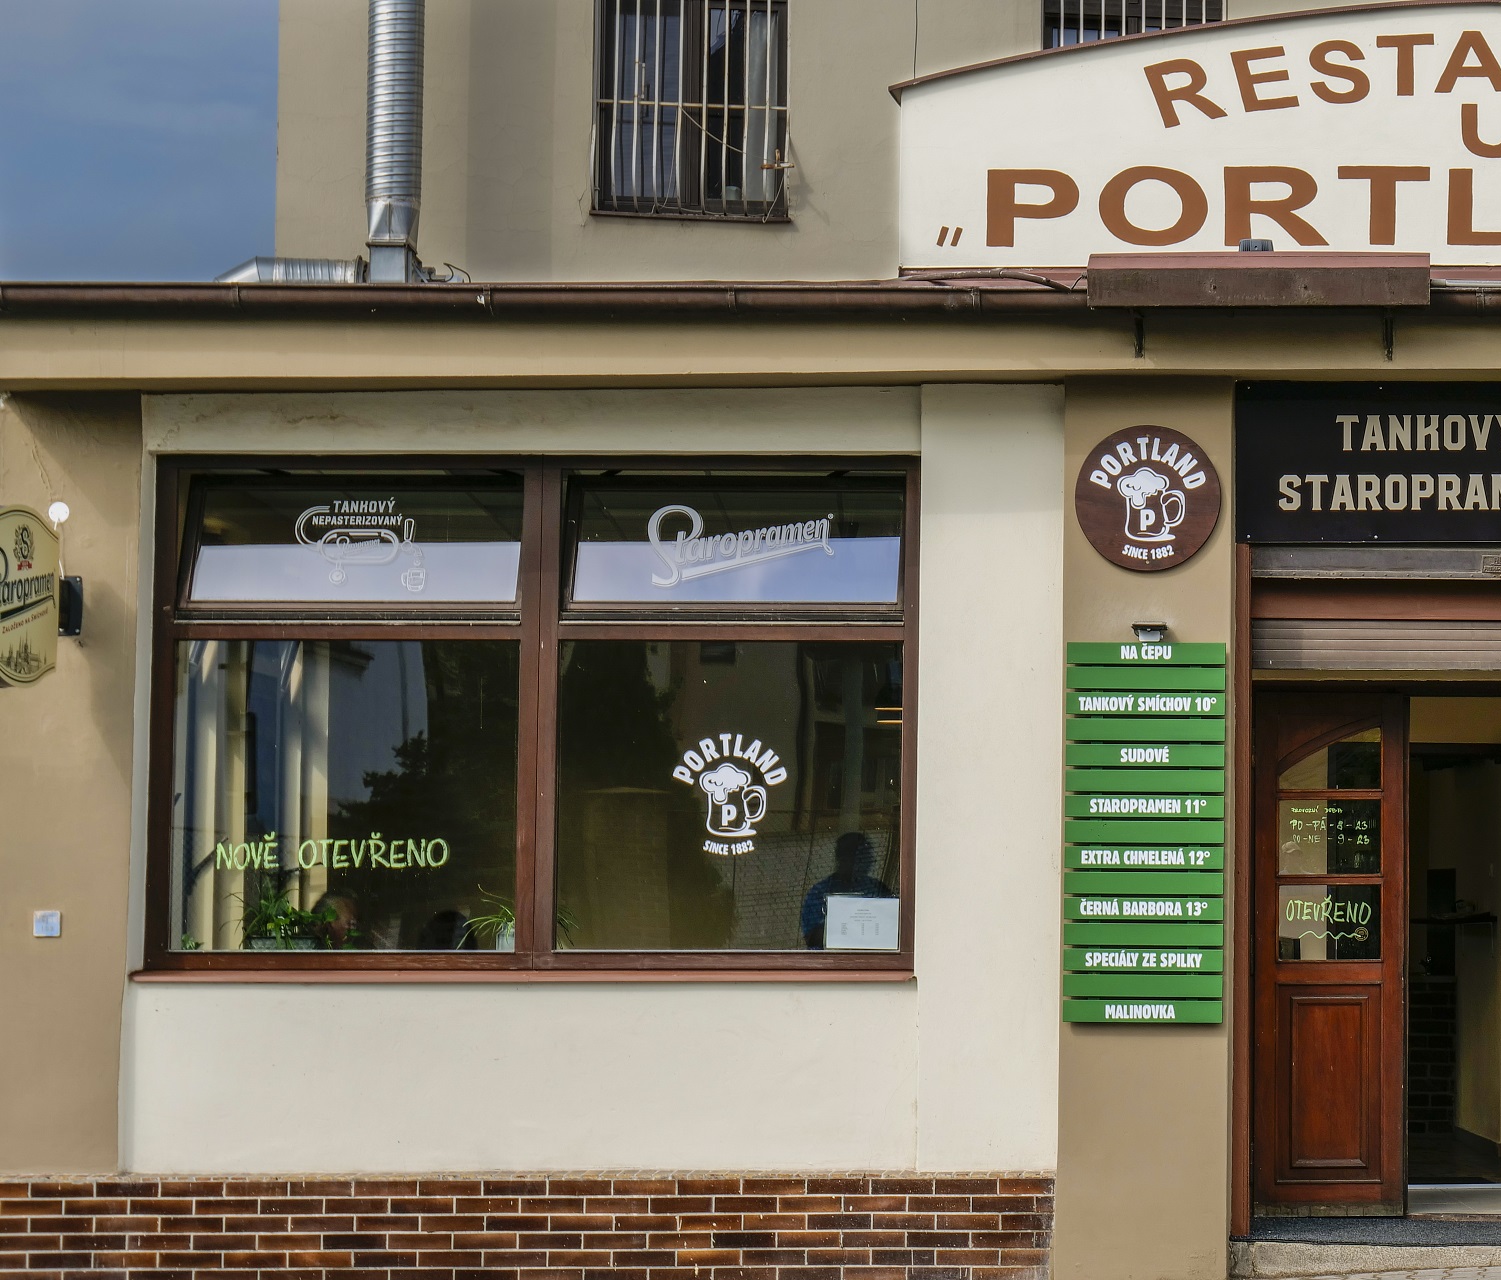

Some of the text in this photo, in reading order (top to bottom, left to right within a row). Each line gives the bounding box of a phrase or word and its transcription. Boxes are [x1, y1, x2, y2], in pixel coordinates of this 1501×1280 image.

[1089, 437, 1207, 490] PORTLAND
[333, 497, 396, 513] TANKOVÝ
[312, 513, 403, 526] NEPASTERIZOVANÝ
[1139, 508, 1156, 531] P
[647, 504, 834, 588] Staropramen
[1121, 544, 1175, 560] SINCE 1882
[1120, 643, 1172, 660] NA ČEPU
[1078, 694, 1217, 712] TANKOVÝ SMÍCHOV 10°
[672, 733, 788, 786] PORTLAND
[1120, 745, 1170, 763] SUDOVÉ
[721, 804, 737, 826] P
[1089, 798, 1207, 814] STAROPRAMEN 11°
[216, 831, 449, 870] NOVĚ OTEVŘENO
[702, 840, 755, 856] SINCE 1882
[1081, 848, 1211, 865] EXTRA CHMELENÁ 12°
[1080, 898, 1208, 916] ČERNÁ BARBORA 13°
[1286, 894, 1372, 925] OTEVŘENO
[1085, 950, 1203, 968] SPECIÁLY ZE SPILKY
[1105, 1004, 1176, 1019] MALINOVKA
